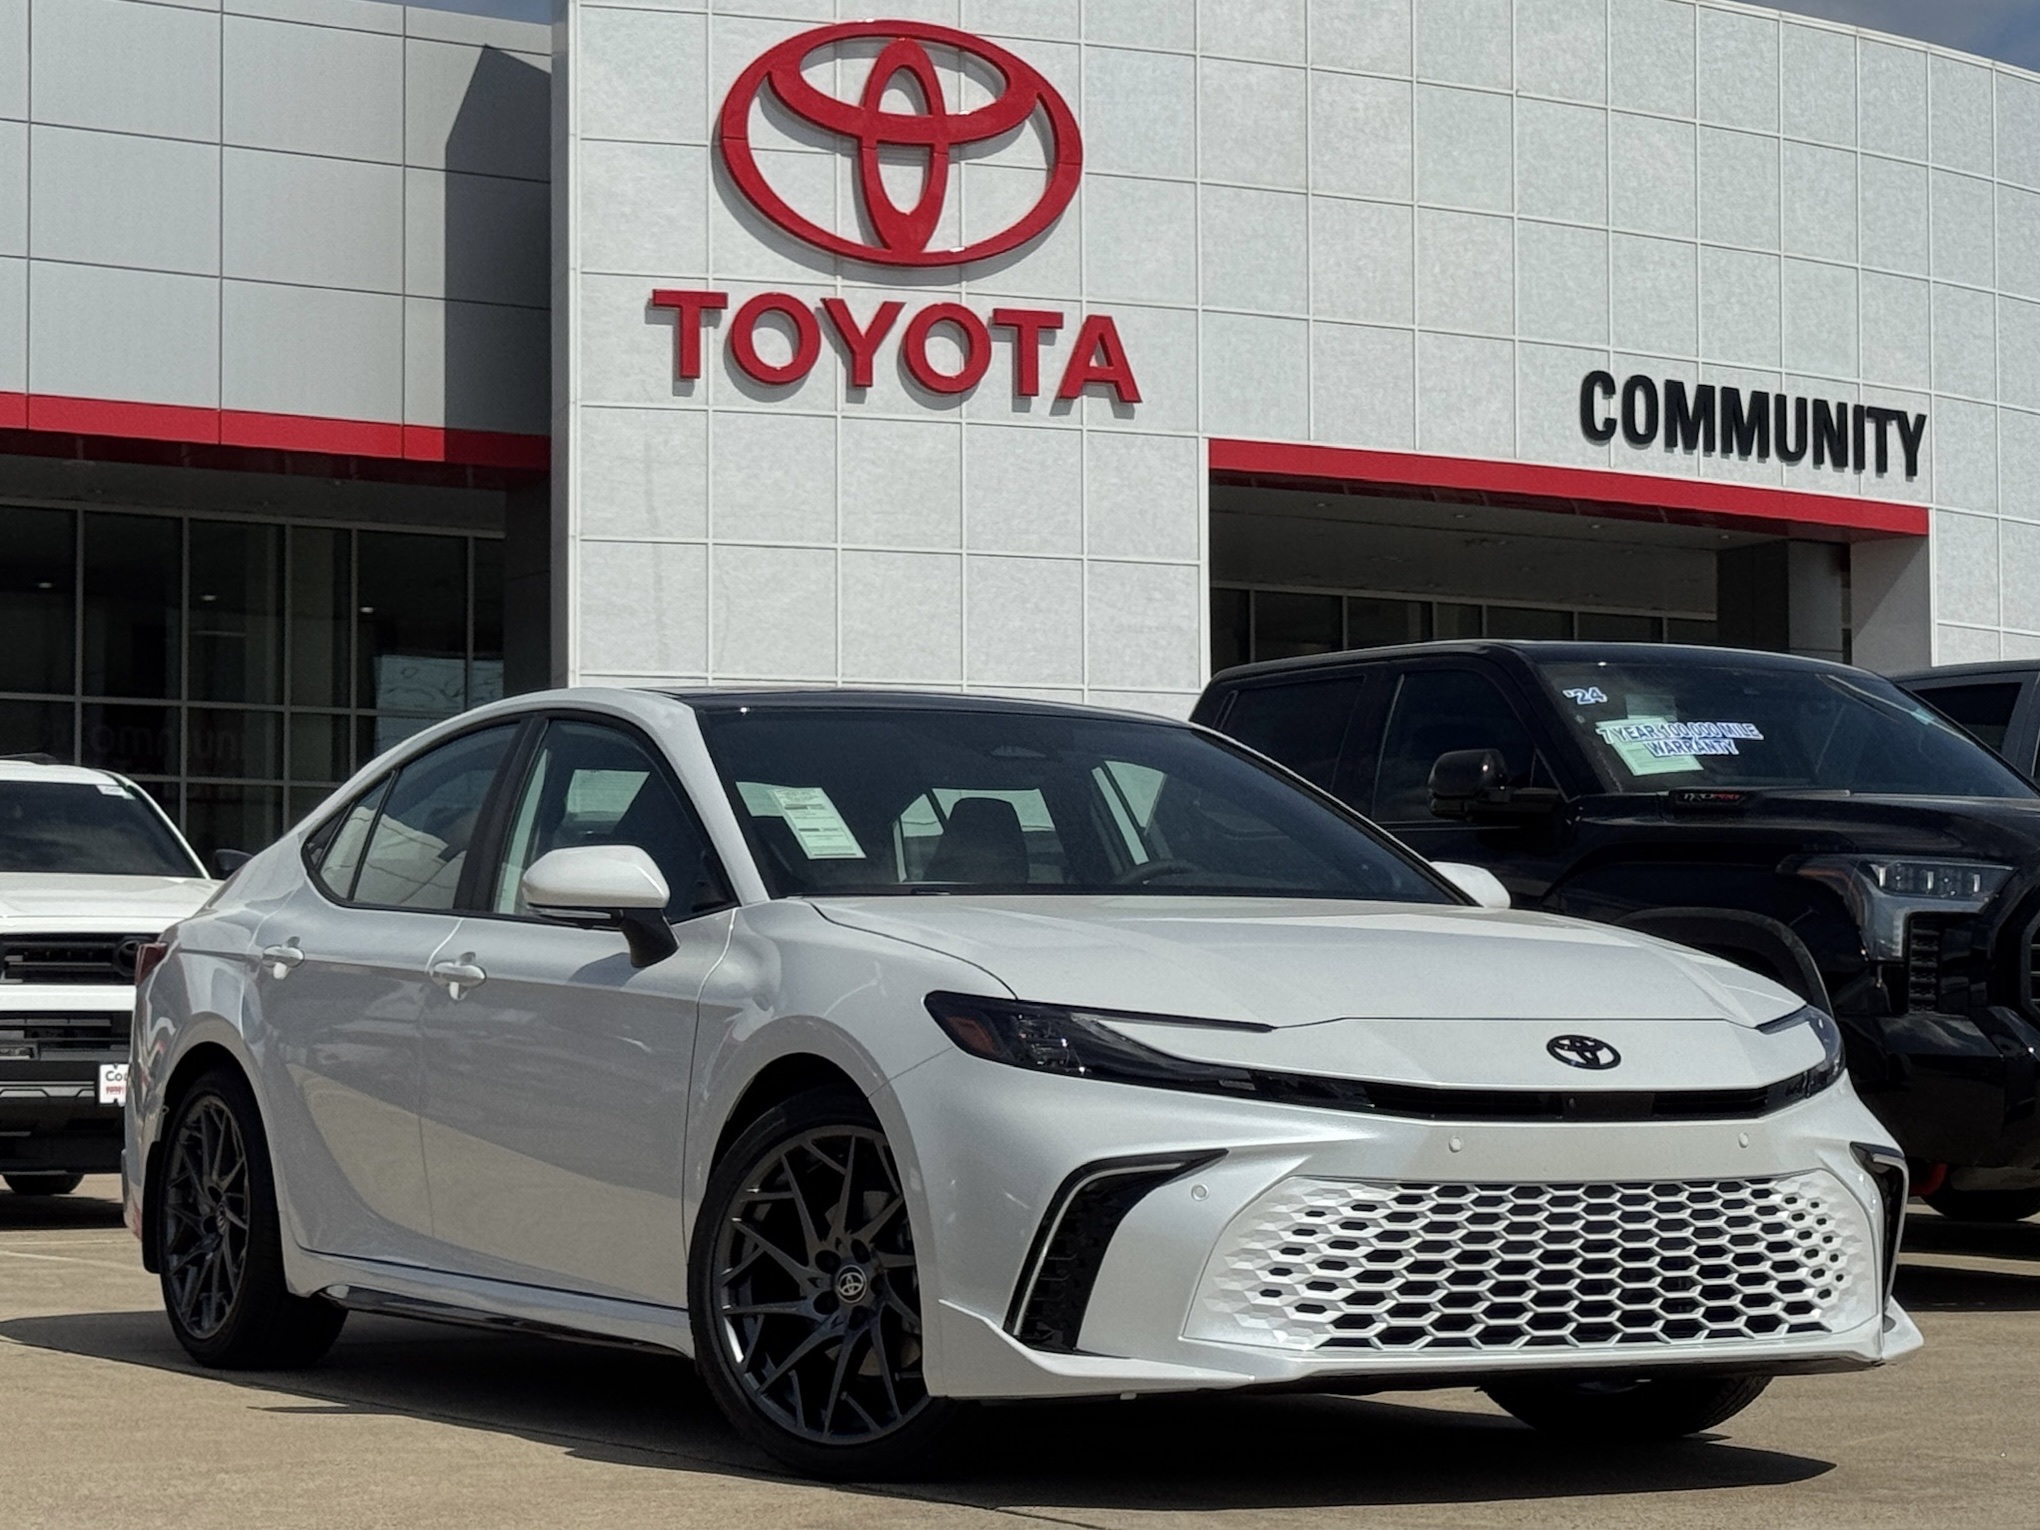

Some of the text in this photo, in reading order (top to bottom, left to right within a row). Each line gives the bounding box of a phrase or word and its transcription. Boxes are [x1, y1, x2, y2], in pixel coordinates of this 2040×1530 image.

[652, 289, 1142, 403] TOYOTA
[1579, 369, 1927, 477] COMMUNITY
[1563, 687, 1607, 704] '24
[1597, 728, 1612, 743] 7
[1612, 724, 1660, 741] YEAR
[1718, 722, 1763, 739] MILE
[1645, 739, 1738, 756] WARRANTY
